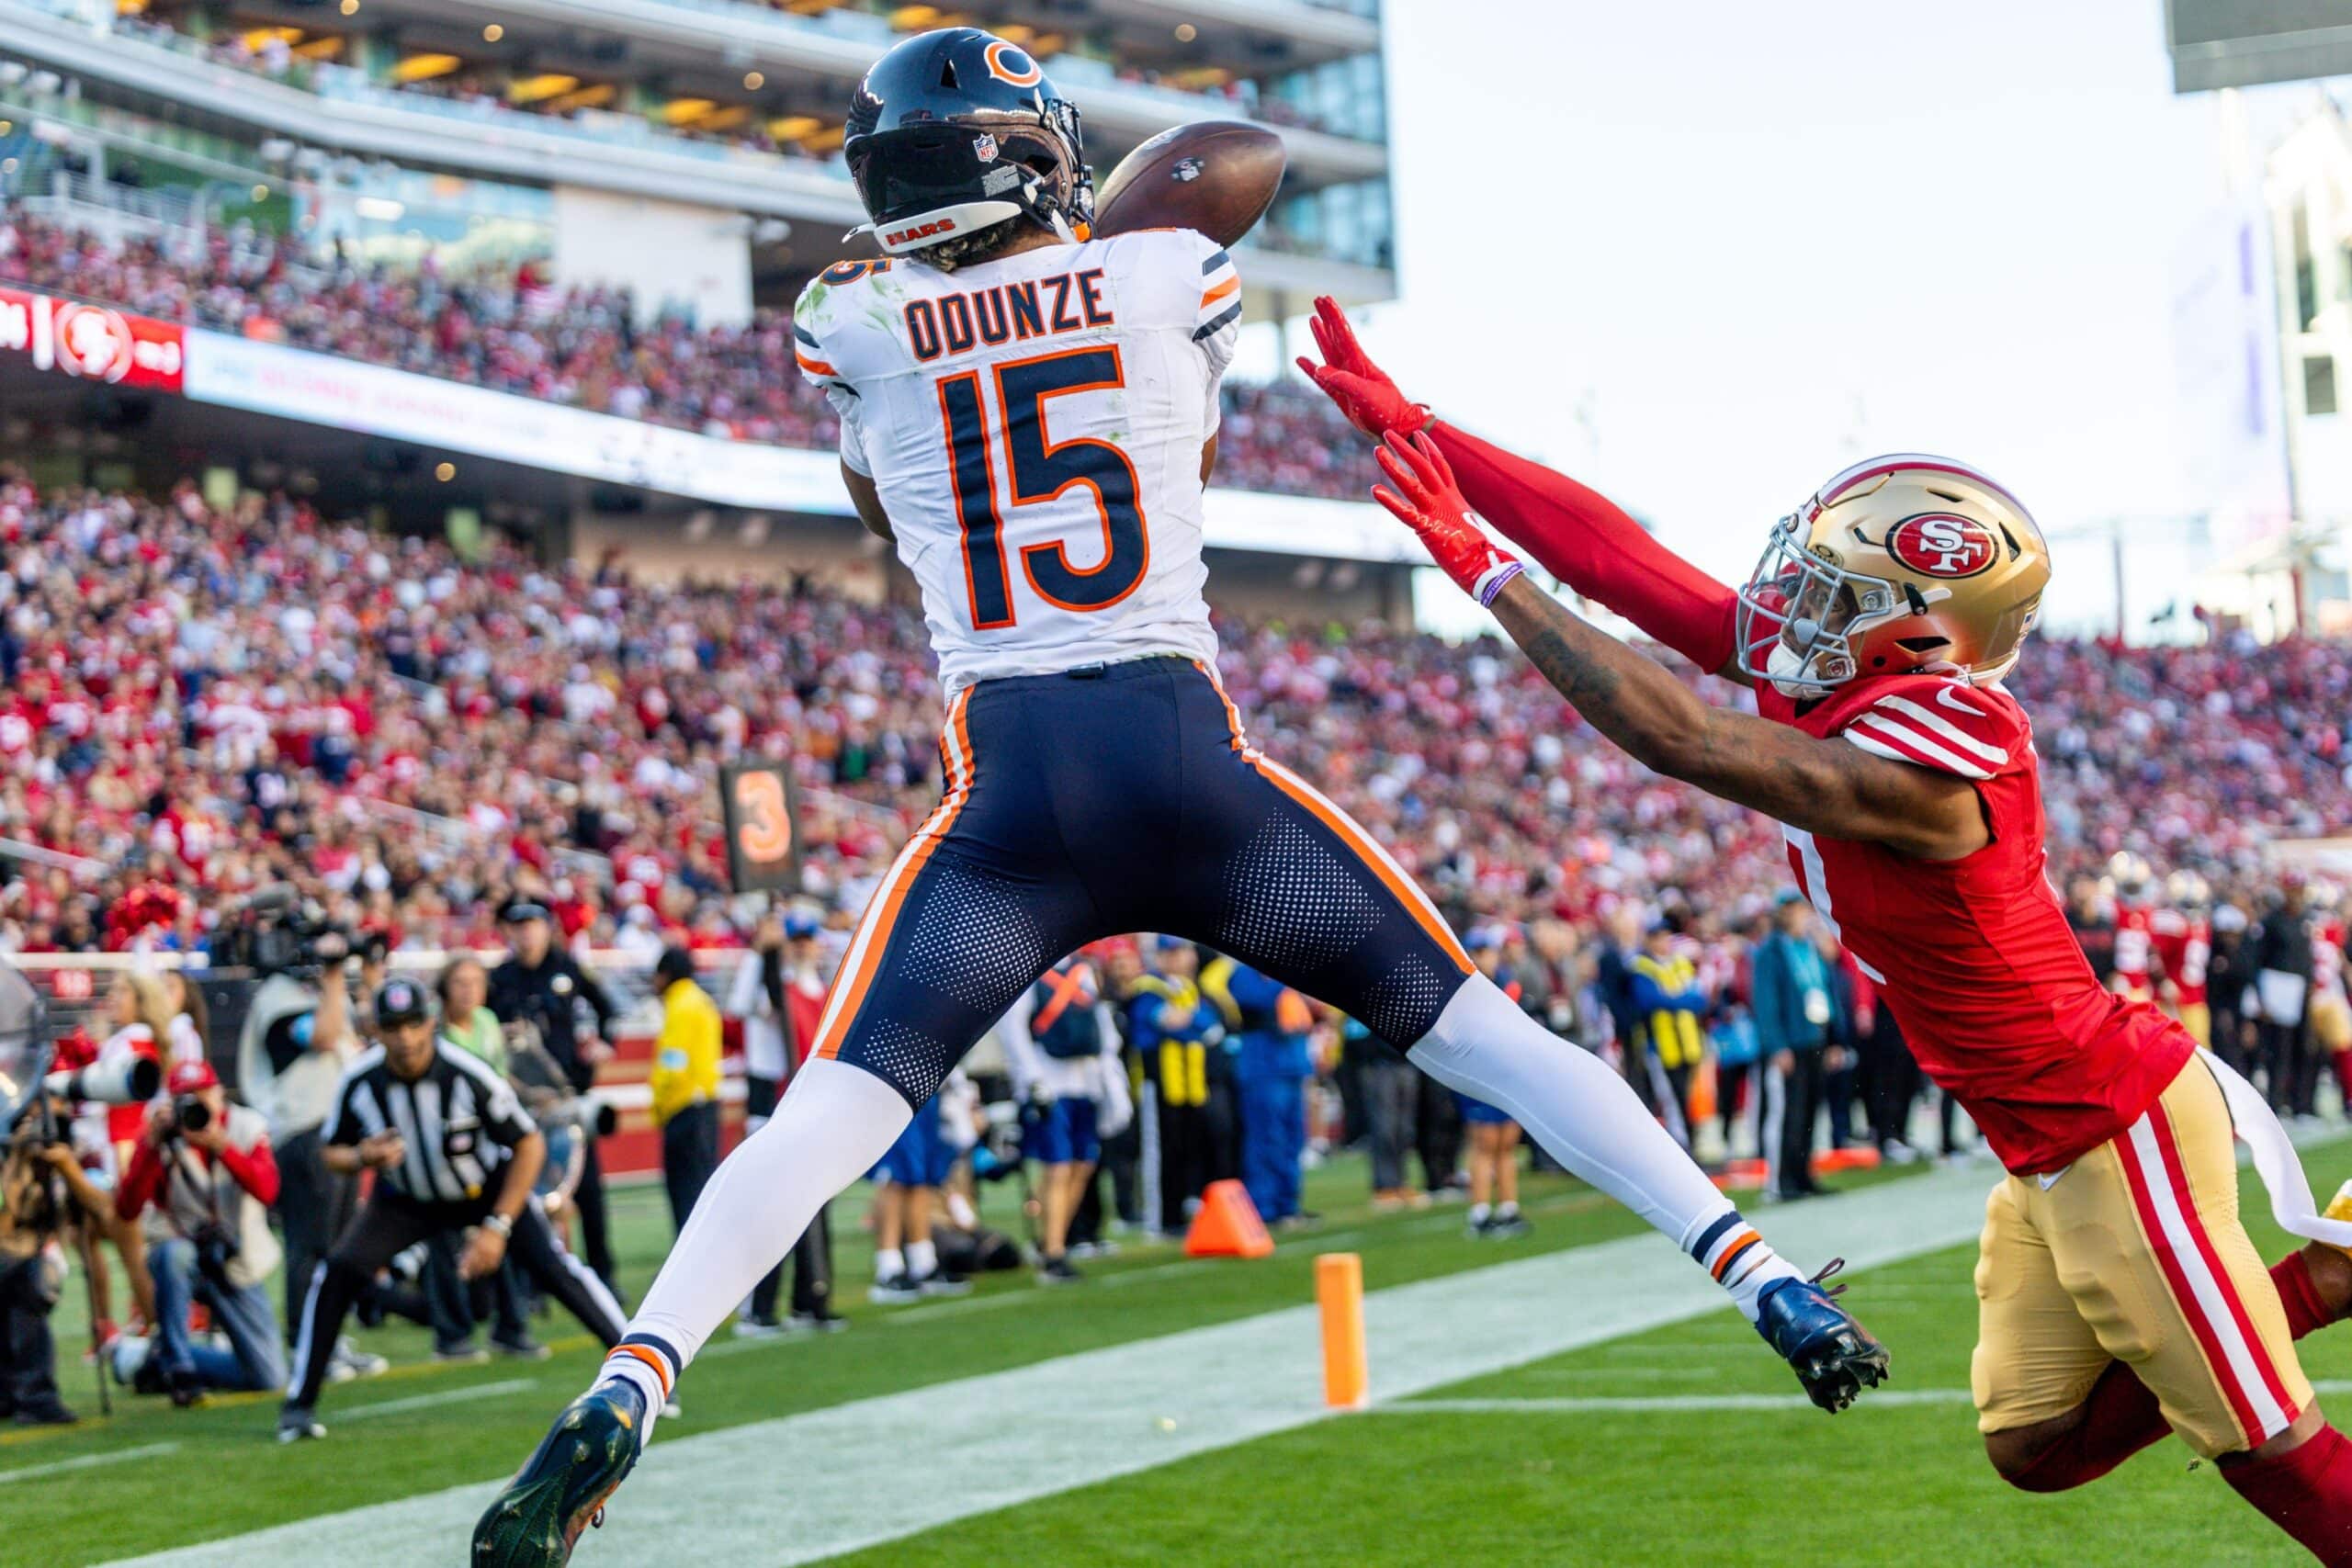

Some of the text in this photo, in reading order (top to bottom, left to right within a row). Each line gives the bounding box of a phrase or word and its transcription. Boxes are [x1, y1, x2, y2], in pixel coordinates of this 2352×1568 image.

[984, 41, 1042, 88] C
[978, 145, 996, 158] NFL
[904, 267, 1114, 362] ODUNZE
[935, 344, 1150, 630] 15
[1919, 520, 1983, 572] SF
[736, 770, 791, 863] 3
